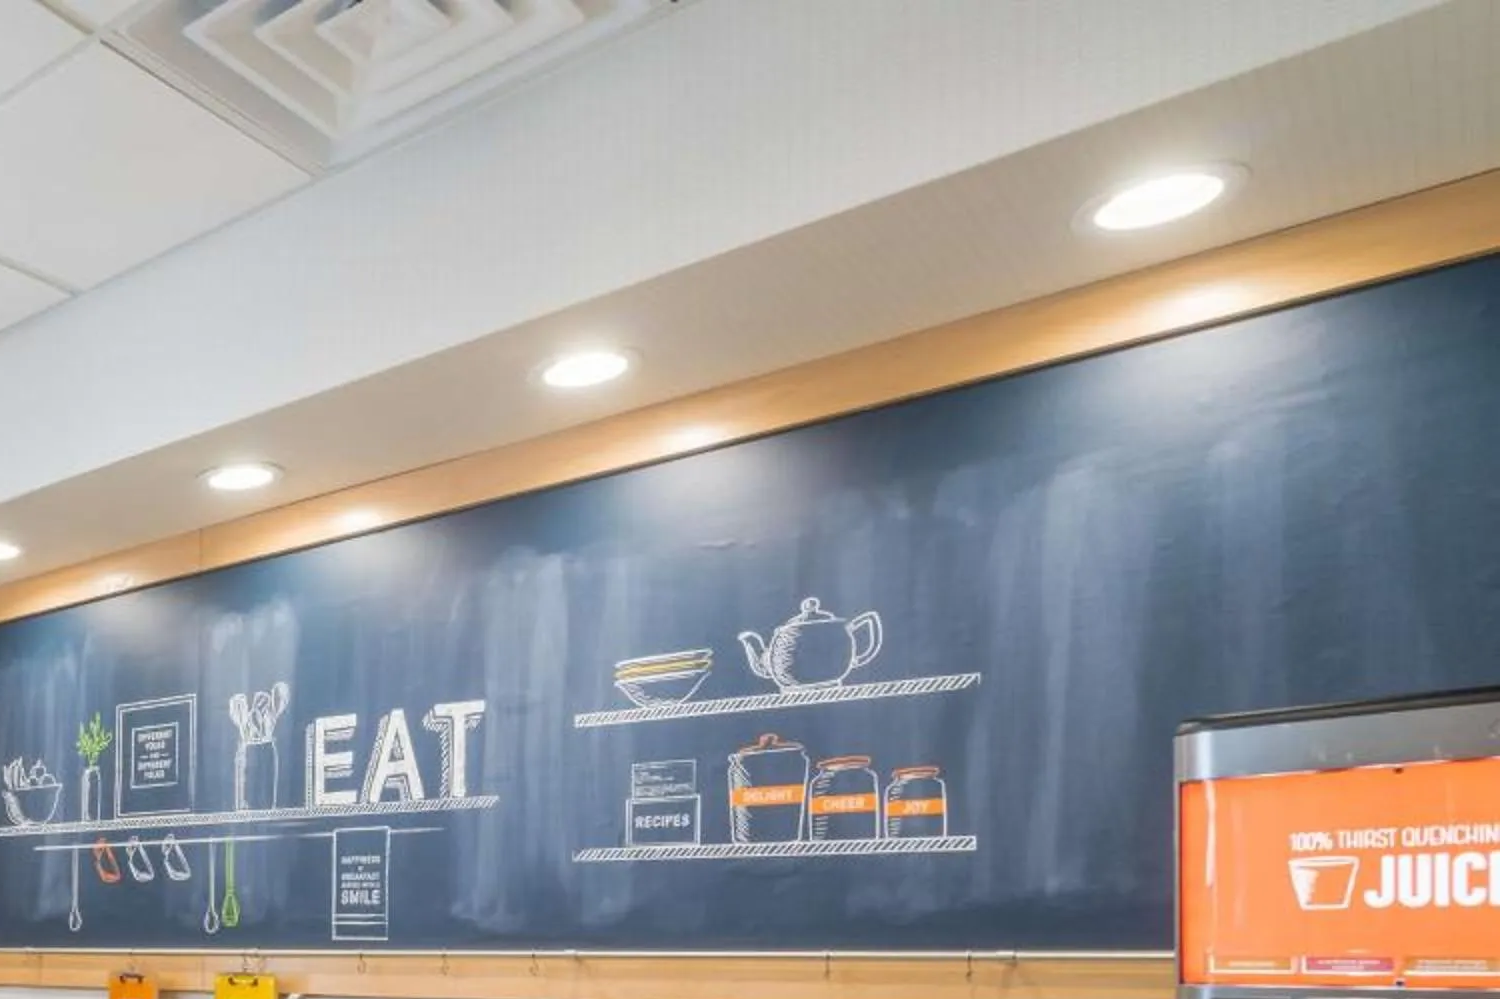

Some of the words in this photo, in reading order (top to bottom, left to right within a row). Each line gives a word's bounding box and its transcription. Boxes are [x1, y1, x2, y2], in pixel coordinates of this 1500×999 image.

[304, 699, 486, 808] EAT
[742, 790, 794, 802] DELIGHT
[822, 797, 865, 811] CHEER
[903, 800, 929, 814] JOY
[634, 813, 691, 829] RECIPES
[1289, 831, 1334, 851] 100%
[1336, 828, 1398, 849] THIRST
[341, 889, 381, 906] SMILE
